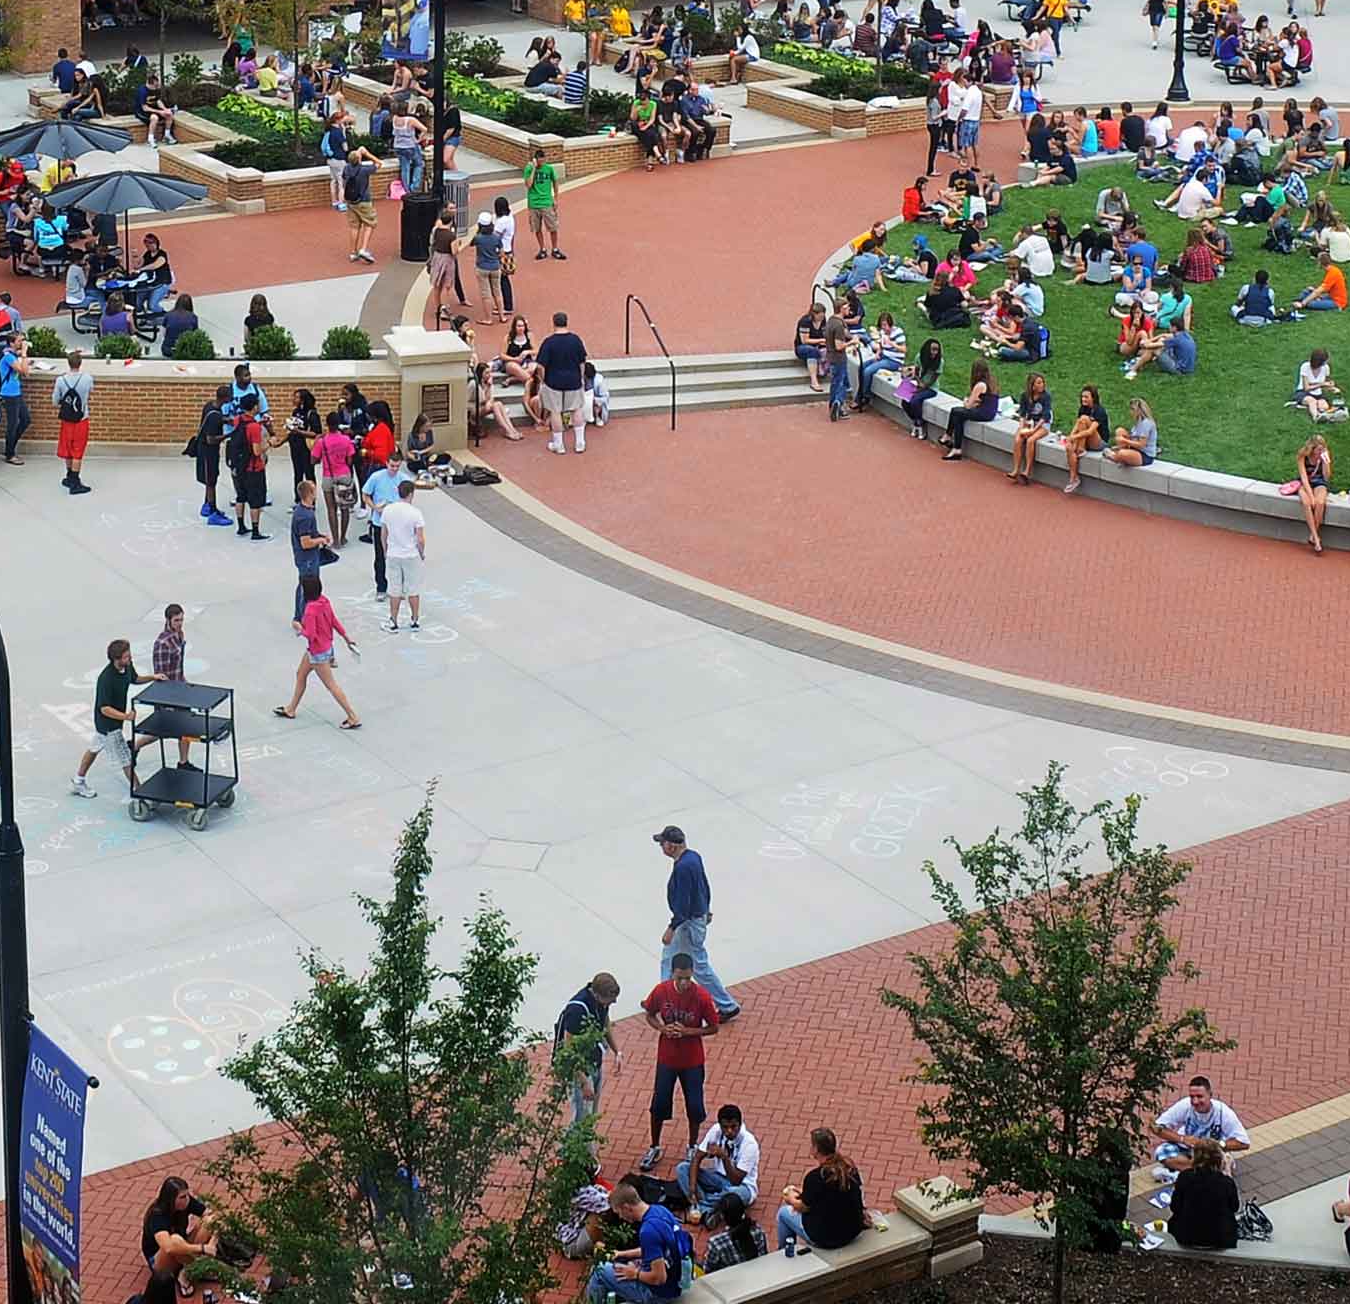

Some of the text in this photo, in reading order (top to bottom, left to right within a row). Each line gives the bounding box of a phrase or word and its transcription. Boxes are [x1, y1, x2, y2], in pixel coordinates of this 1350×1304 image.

[31, 1052, 54, 1090] KENT
[55, 1077, 82, 1117] STATE
[30, 1133, 71, 1182] one of the
[36, 1112, 66, 1156] Named
[23, 1183, 77, 1251] in the world.
